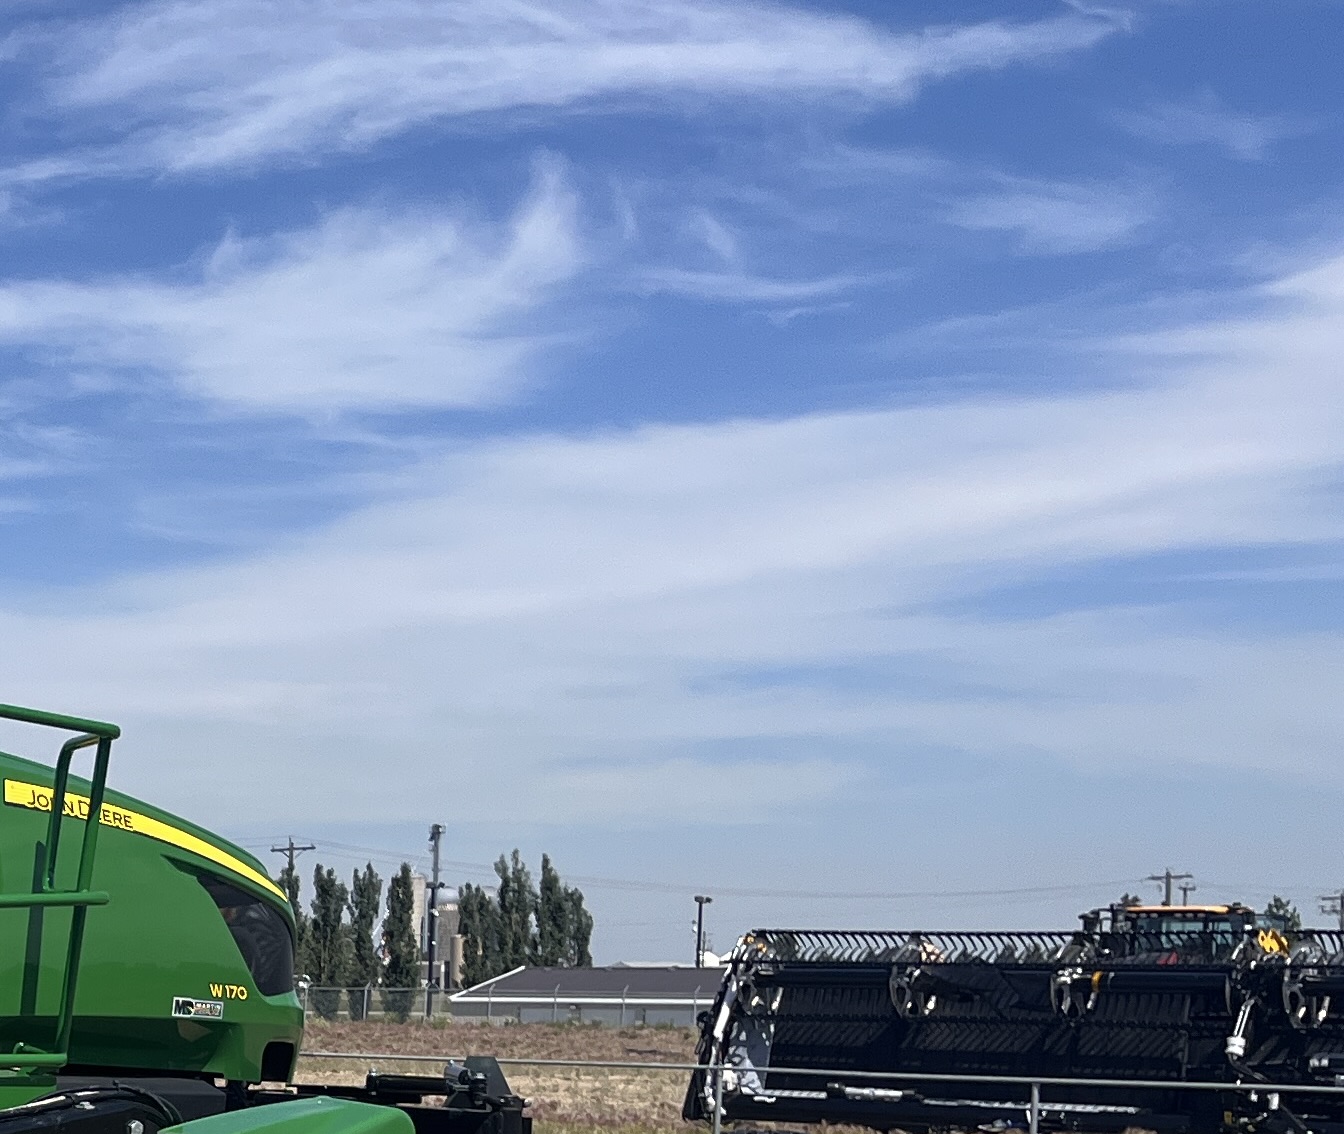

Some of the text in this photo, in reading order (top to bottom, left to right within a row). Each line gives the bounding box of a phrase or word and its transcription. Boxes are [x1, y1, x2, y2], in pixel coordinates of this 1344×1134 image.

[27, 790, 134, 829] JON DERE
[209, 983, 248, 1000] W 170
